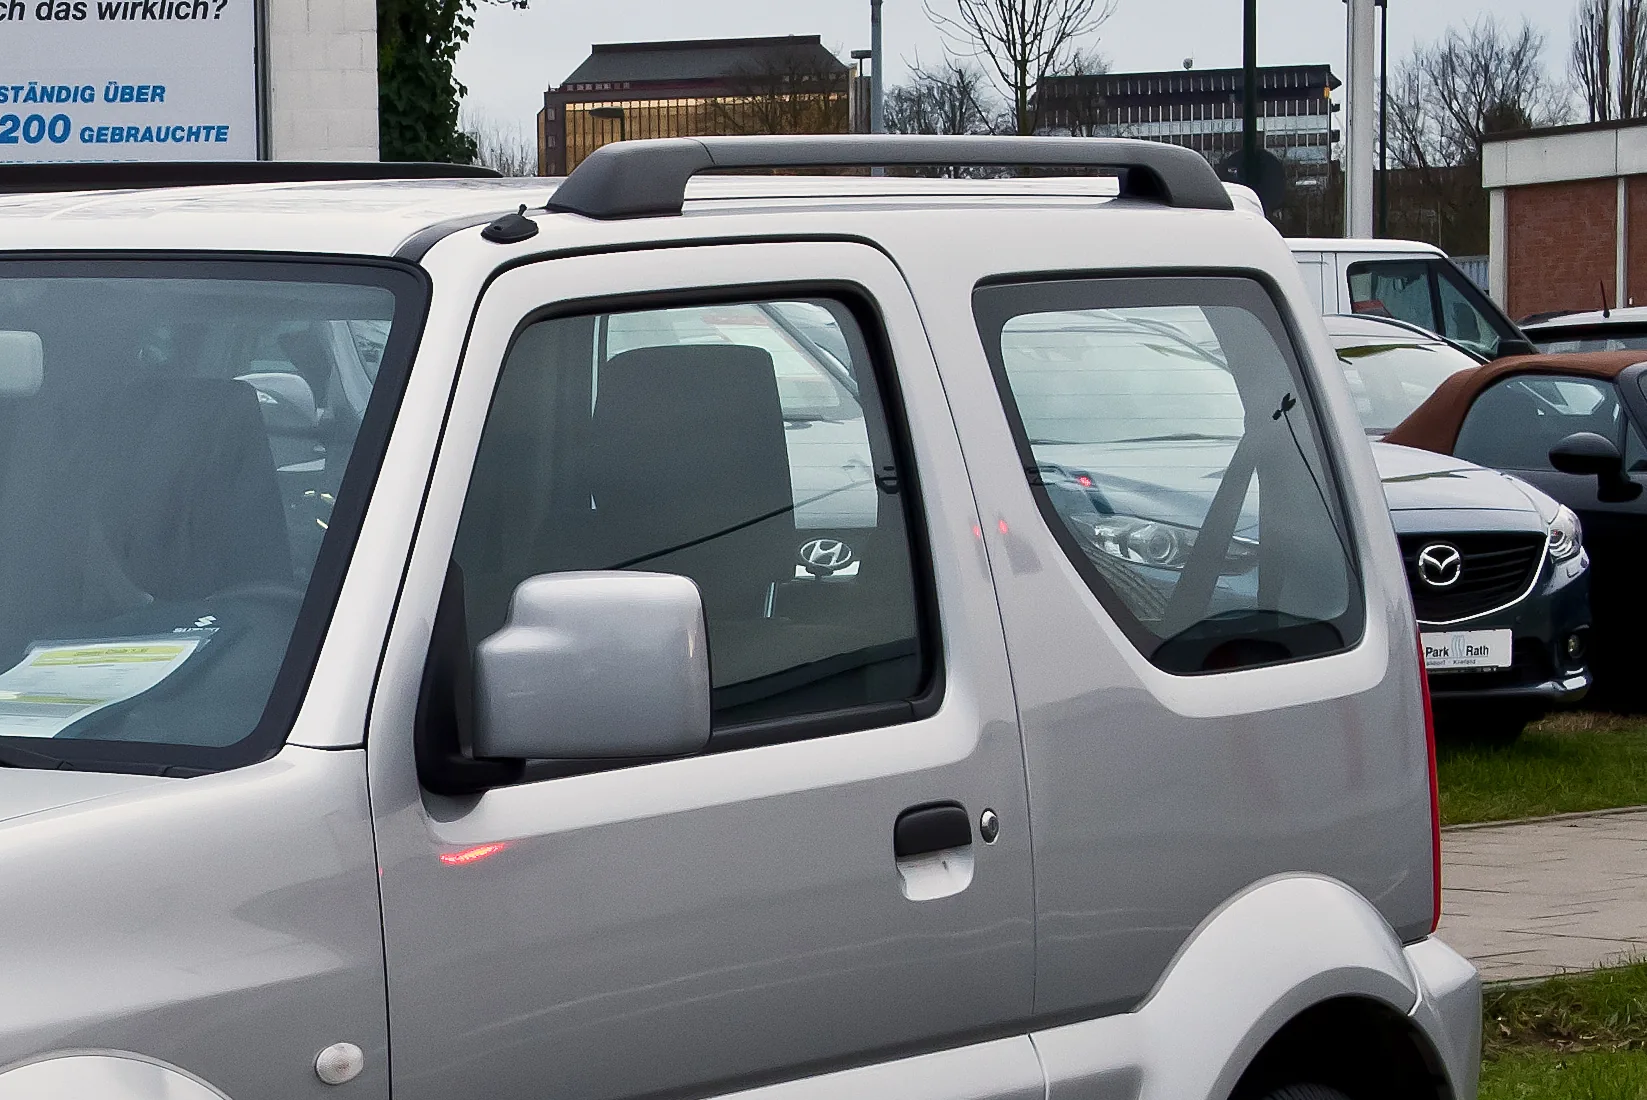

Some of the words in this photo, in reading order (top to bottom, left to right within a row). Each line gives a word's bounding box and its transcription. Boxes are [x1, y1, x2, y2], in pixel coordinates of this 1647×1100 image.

[35, 0, 87, 21] das
[97, 0, 228, 21] wirklich?
[103, 80, 166, 103] ÜBER
[80, 125, 229, 143] GEBRAUCHTE
[1425, 645, 1449, 657] Park
[1466, 645, 1489, 656] Rath
